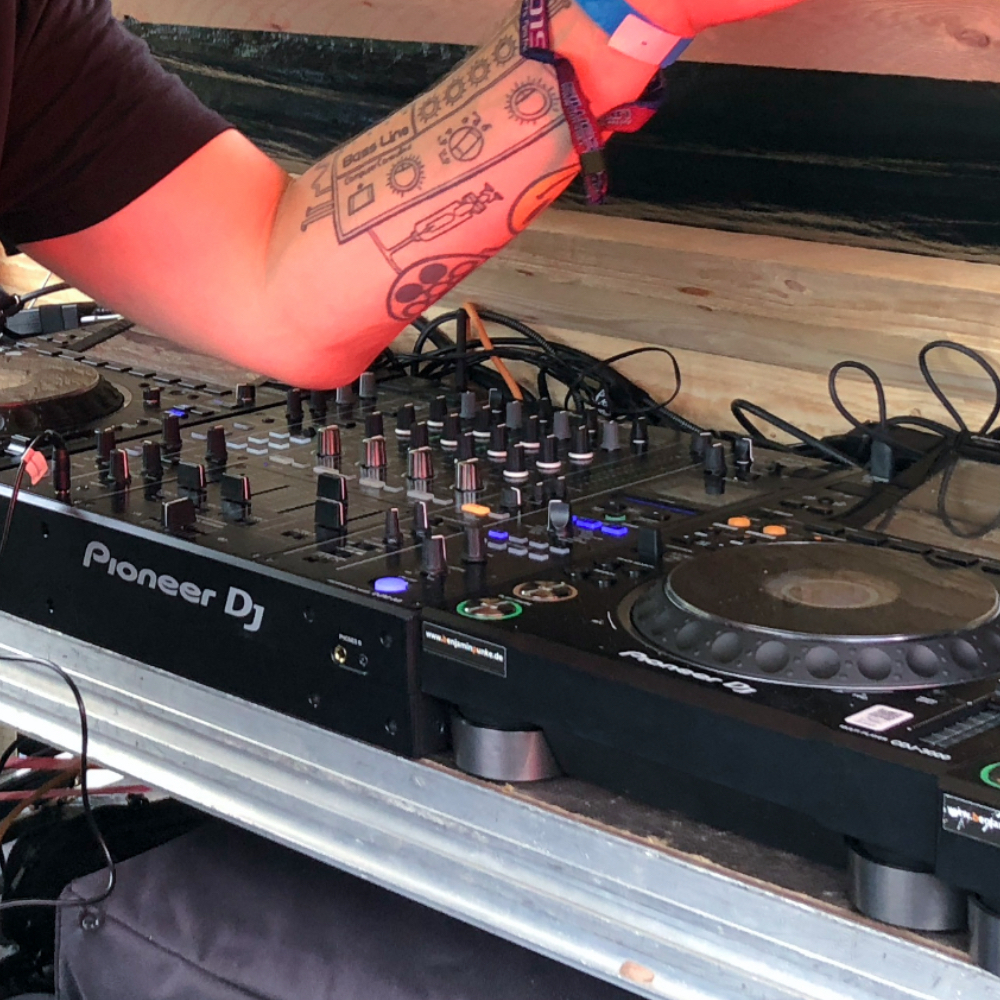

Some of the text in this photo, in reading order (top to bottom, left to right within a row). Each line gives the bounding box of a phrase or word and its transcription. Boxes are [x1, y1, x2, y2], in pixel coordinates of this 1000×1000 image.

[342, 142, 377, 168] Bass
[380, 126, 409, 147] Line
[82, 540, 217, 607] Pioneer
